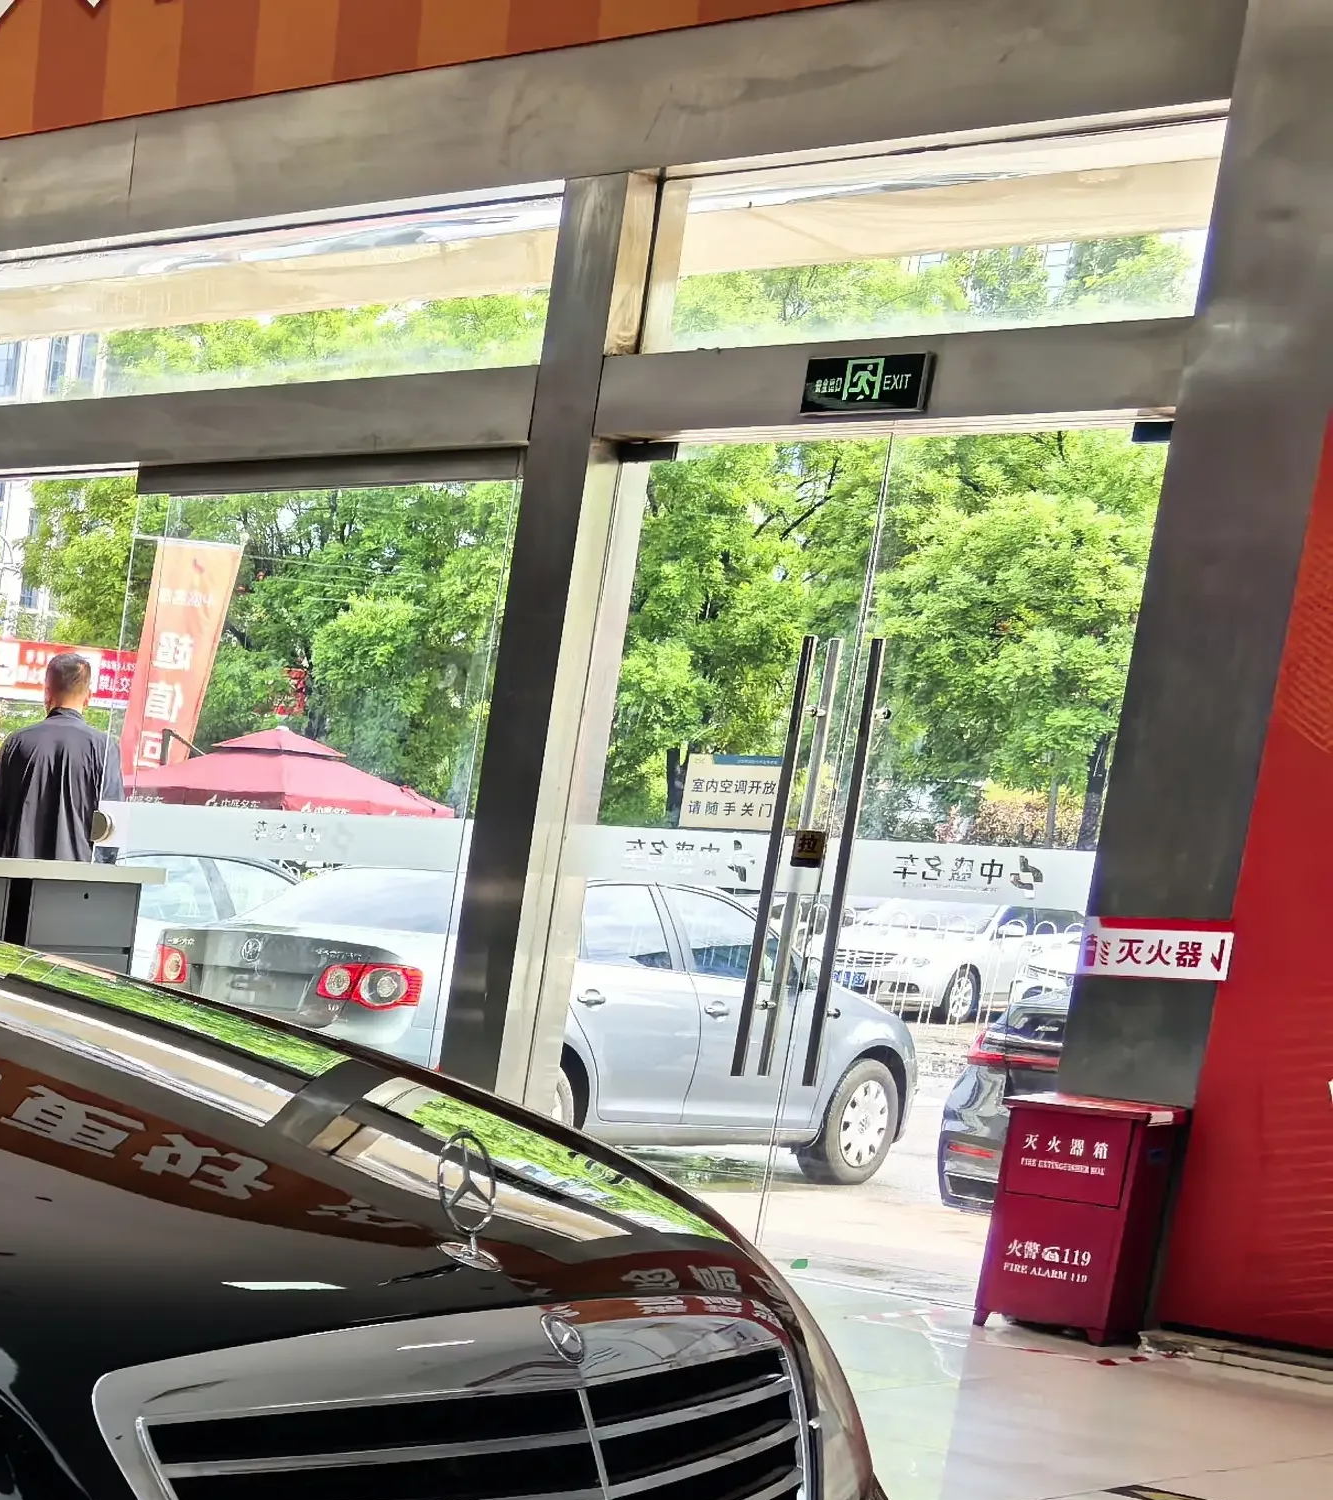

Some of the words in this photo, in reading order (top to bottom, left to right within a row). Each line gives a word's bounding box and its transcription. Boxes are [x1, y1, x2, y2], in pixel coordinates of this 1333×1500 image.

[882, 373, 912, 390] EXIT
[690, 777, 778, 795] 室内空调开放
[687, 800, 773, 818] 请随手关门
[1115, 937, 1203, 969] 灭火器
[1022, 1133, 1109, 1160] 灭火器箱
[1020, 1157, 1037, 1168] FIRE
[1005, 1239, 1041, 1260] 火警
[1061, 1248, 1092, 1267] 119
[1003, 1262, 1028, 1276] FIRE
[1030, 1265, 1068, 1281] ALARM
